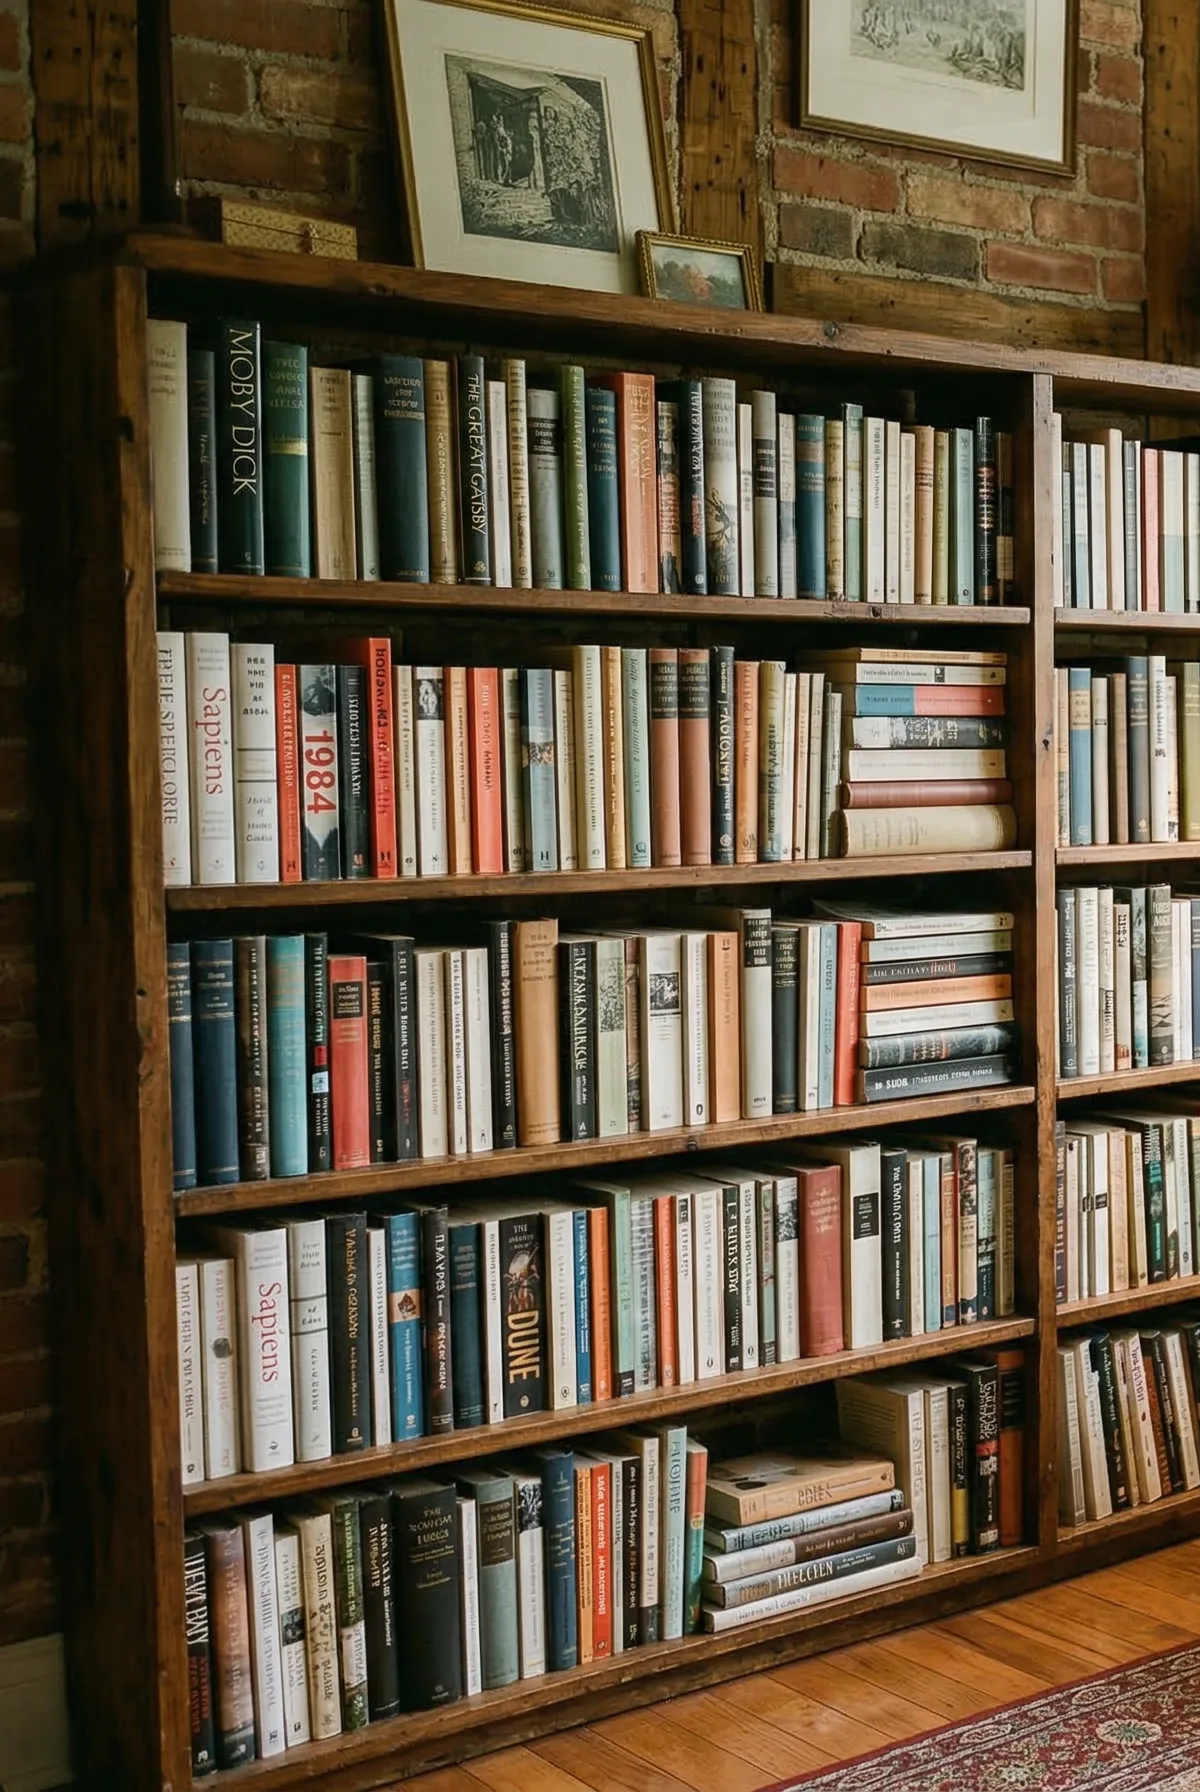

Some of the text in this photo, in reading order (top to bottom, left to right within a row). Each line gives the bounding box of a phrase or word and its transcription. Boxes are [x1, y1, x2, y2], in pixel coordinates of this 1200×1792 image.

[229, 328, 257, 495] MOBY DICK
[467, 373, 480, 402] THE
[468, 406, 485, 467] GREAT
[195, 686, 229, 795] Sapiens
[304, 729, 337, 814] 1984
[251, 1282, 285, 1383] Sapiens
[507, 1310, 540, 1385] DUNE
